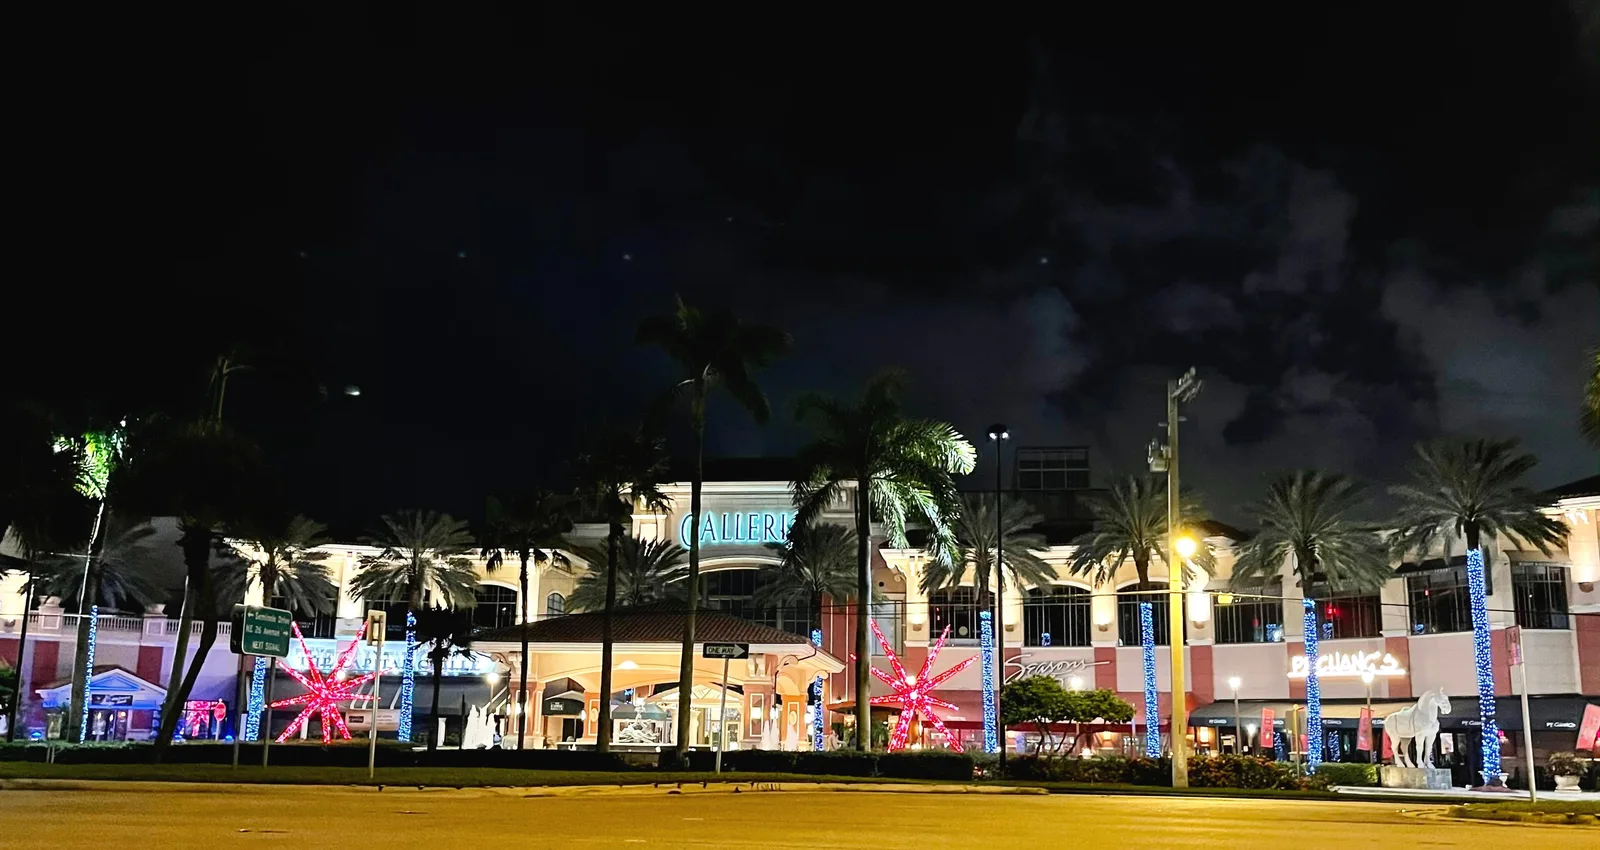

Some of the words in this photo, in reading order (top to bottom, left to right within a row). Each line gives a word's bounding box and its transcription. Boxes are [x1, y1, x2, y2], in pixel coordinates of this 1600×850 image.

[681, 513, 787, 546] GALLERI
[341, 656, 411, 671] CAPTA
[417, 659, 481, 671] GILLE
